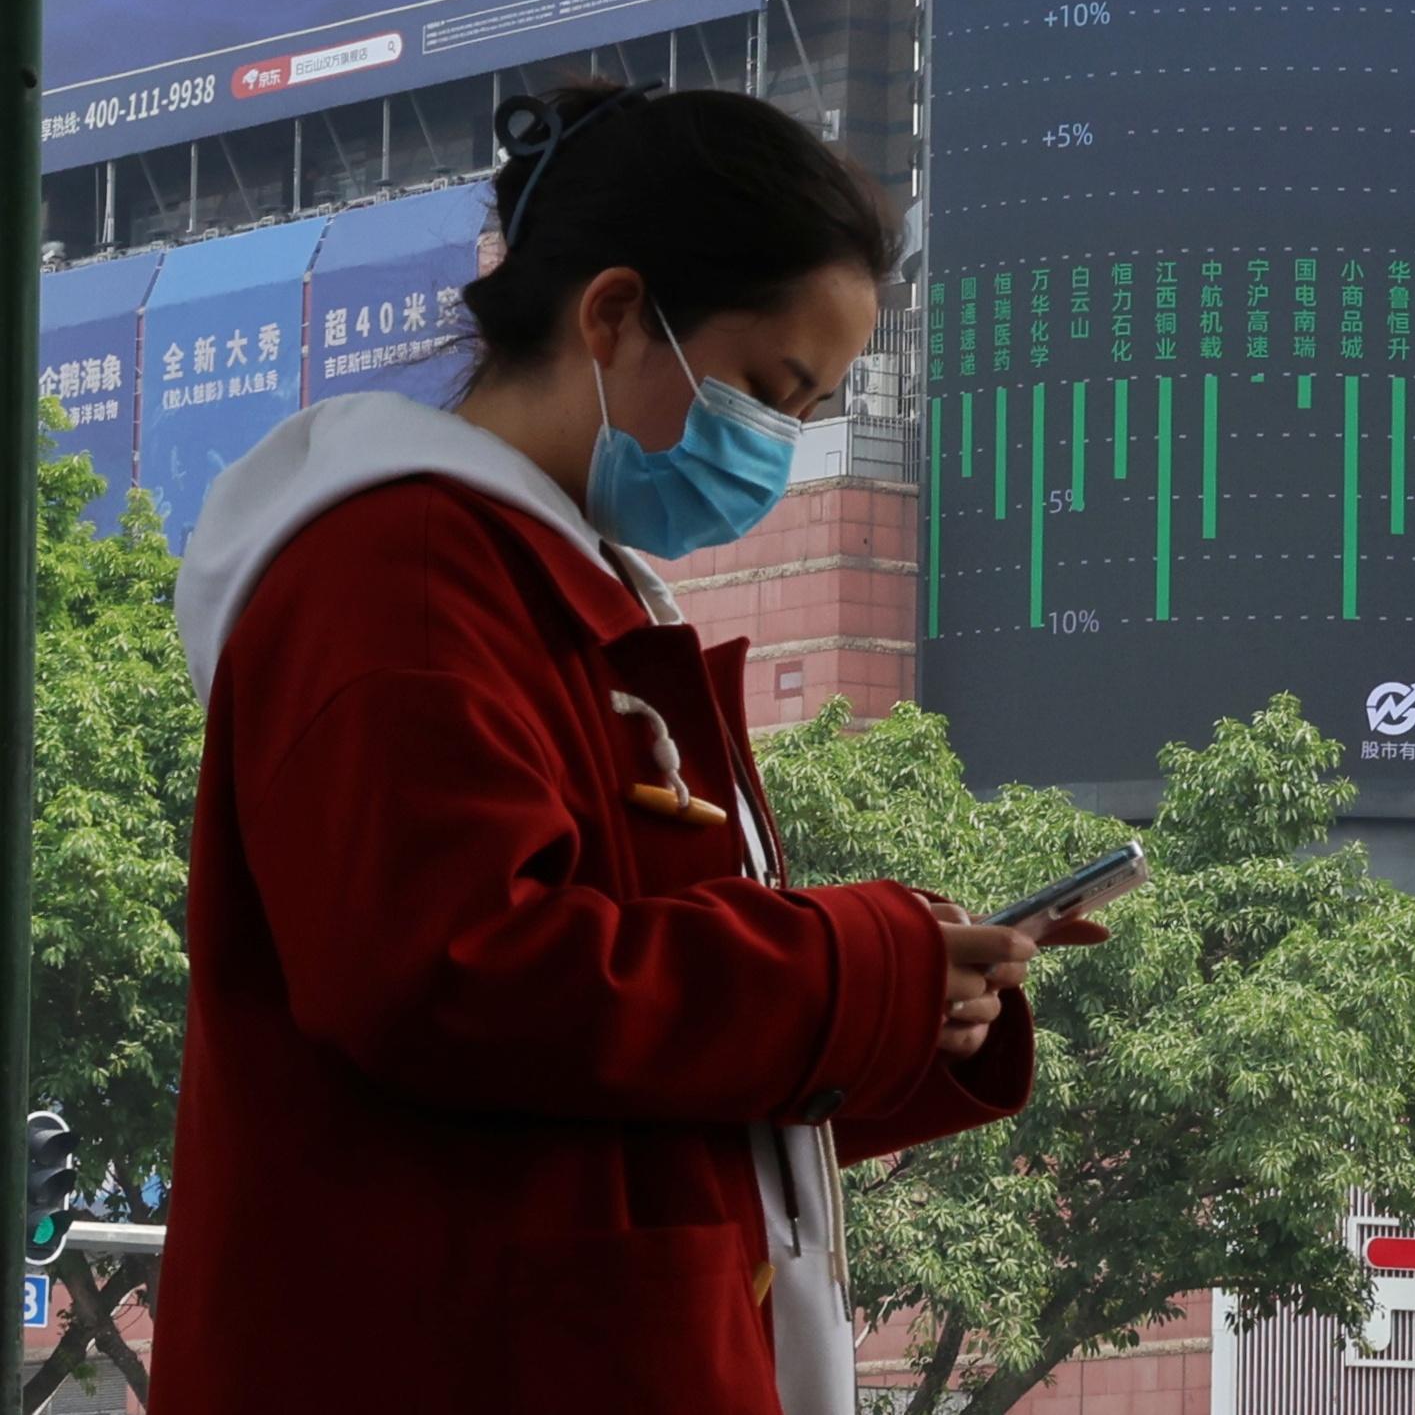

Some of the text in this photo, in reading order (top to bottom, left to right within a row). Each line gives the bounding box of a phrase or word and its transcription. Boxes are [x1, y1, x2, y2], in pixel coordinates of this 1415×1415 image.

[1044, 1, 1111, 28] +10%
[84, 74, 216, 130] 400-111-9938
[258, 68, 282, 88] 京东
[1042, 122, 1093, 148] +5%
[162, 321, 281, 381] 全新大秀
[993, 272, 1012, 371] 恒瑞医药
[1030, 268, 1050, 368] 万华化学
[1070, 266, 1090, 339] 白云山
[1111, 263, 1132, 363] 恒力石化
[1154, 261, 1177, 361] 江西铜业
[1200, 259, 1223, 360] 中航机载
[1246, 258, 1270, 359] 宁沪高速
[1293, 258, 1317, 359] 国电南瑞
[1340, 259, 1364, 359] 小商品城
[1387, 261, 1411, 361] 华鲁恒升
[38, 353, 122, 400] 企鹅海象
